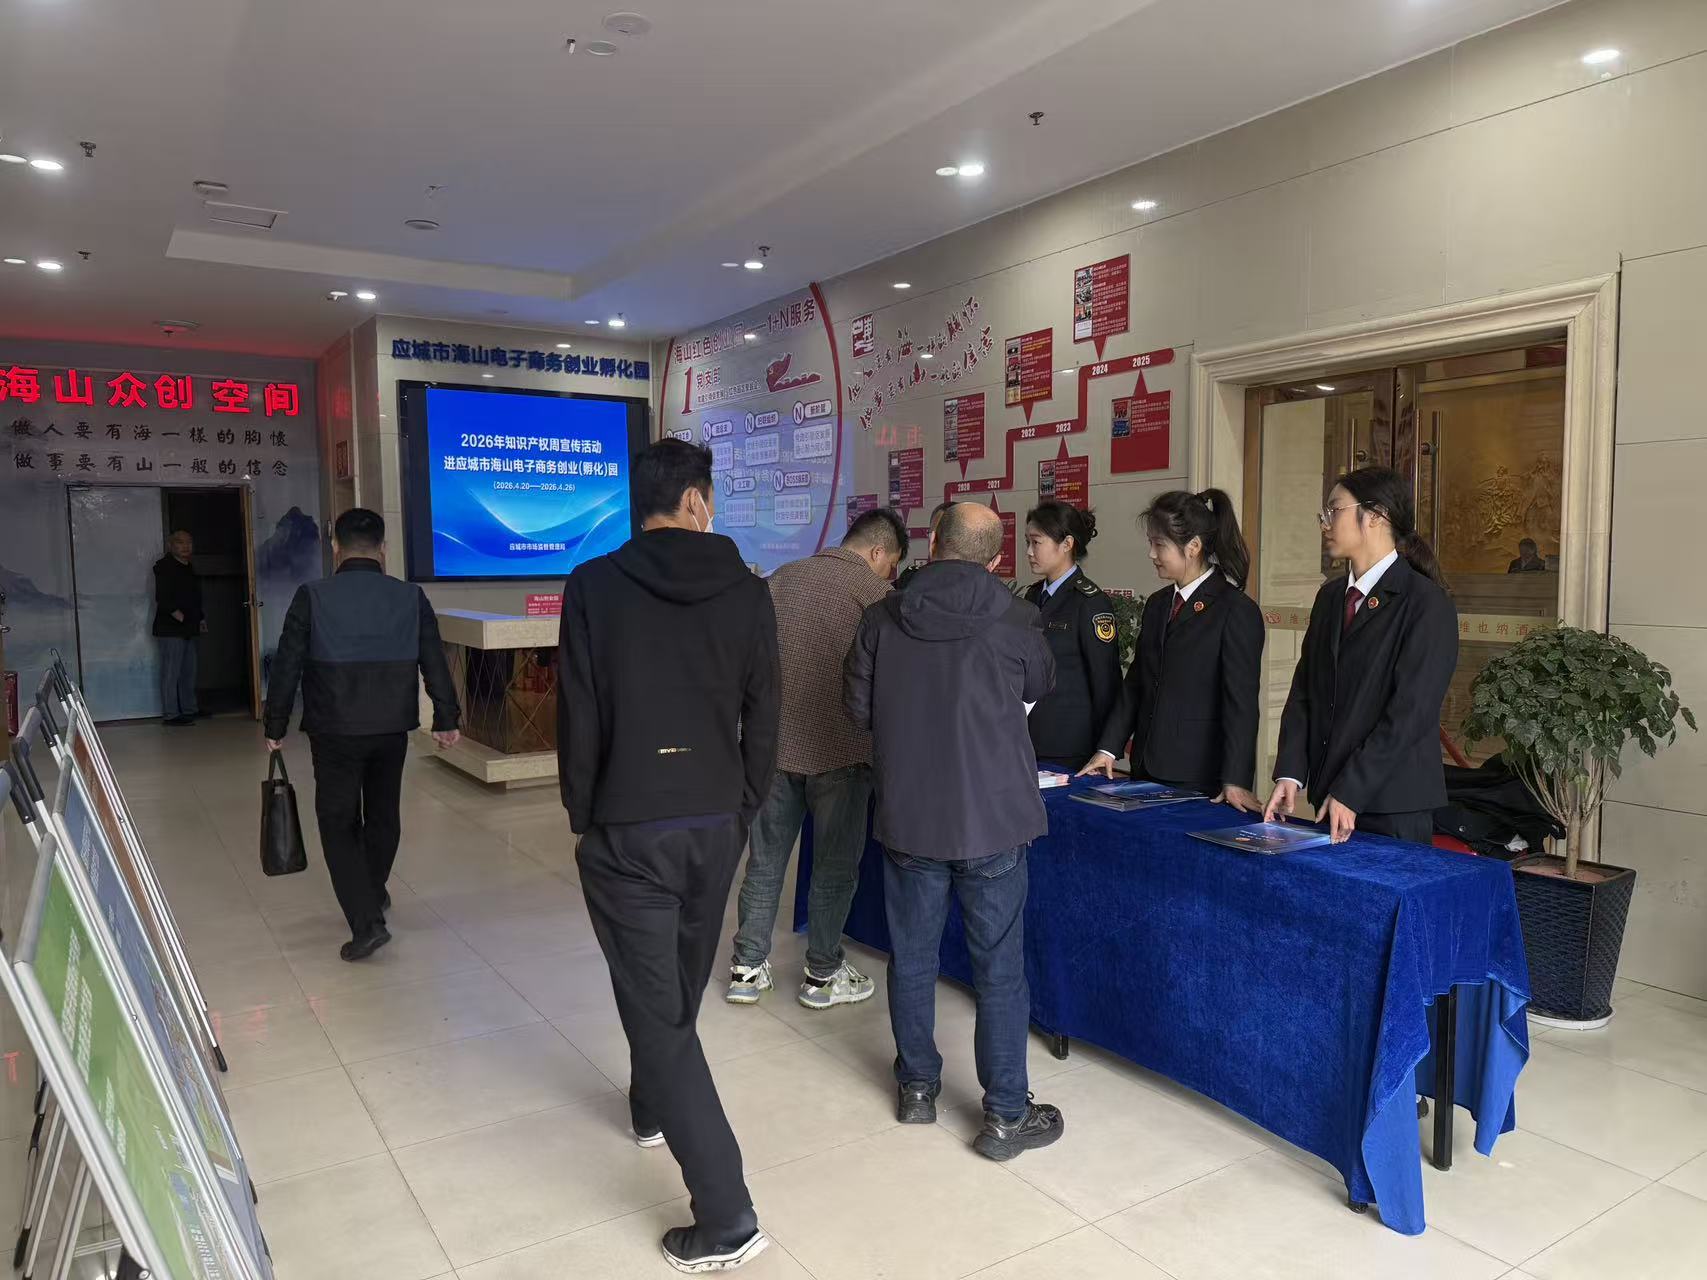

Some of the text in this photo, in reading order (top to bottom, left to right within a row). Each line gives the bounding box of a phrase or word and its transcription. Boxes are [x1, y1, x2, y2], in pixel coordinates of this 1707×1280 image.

[391, 339, 650, 380] 应城市海山电子商务创业孵化园
[1132, 355, 1151, 367] 2025
[1091, 364, 1109, 377] 2024
[0, 366, 300, 417] 海山众创空间
[1021, 428, 1036, 438] 2022
[1055, 423, 1072, 433] 2023
[461, 433, 602, 454] 2026年知识产权周宣传活动
[14, 452, 289, 476] 做事要有山一般的信念
[957, 483, 971, 492] 2020
